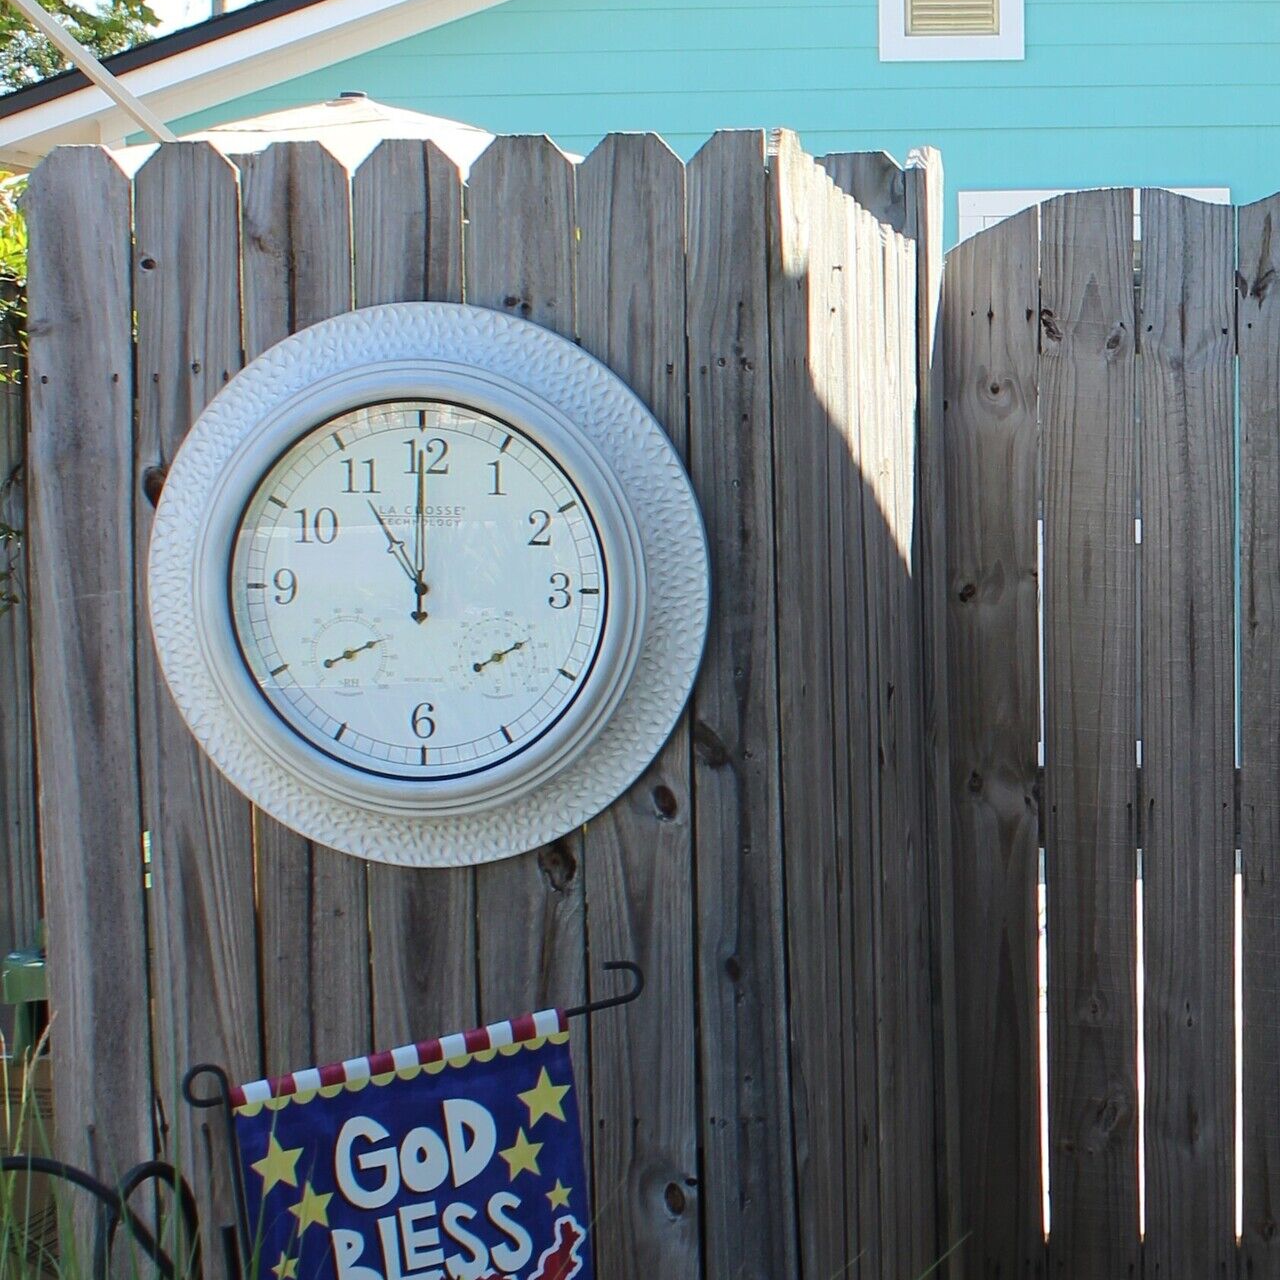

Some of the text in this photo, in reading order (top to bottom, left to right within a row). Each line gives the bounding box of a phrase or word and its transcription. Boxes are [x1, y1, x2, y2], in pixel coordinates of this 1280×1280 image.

[403, 438, 449, 474] 12
[340, 458, 381, 493] 11
[488, 460, 507, 496] 1
[294, 507, 339, 544] 10
[404, 505, 462, 516] COSSE
[527, 509, 551, 546] 2
[273, 568, 298, 605] 9
[548, 572, 572, 609] 3
[411, 702, 435, 739] 6
